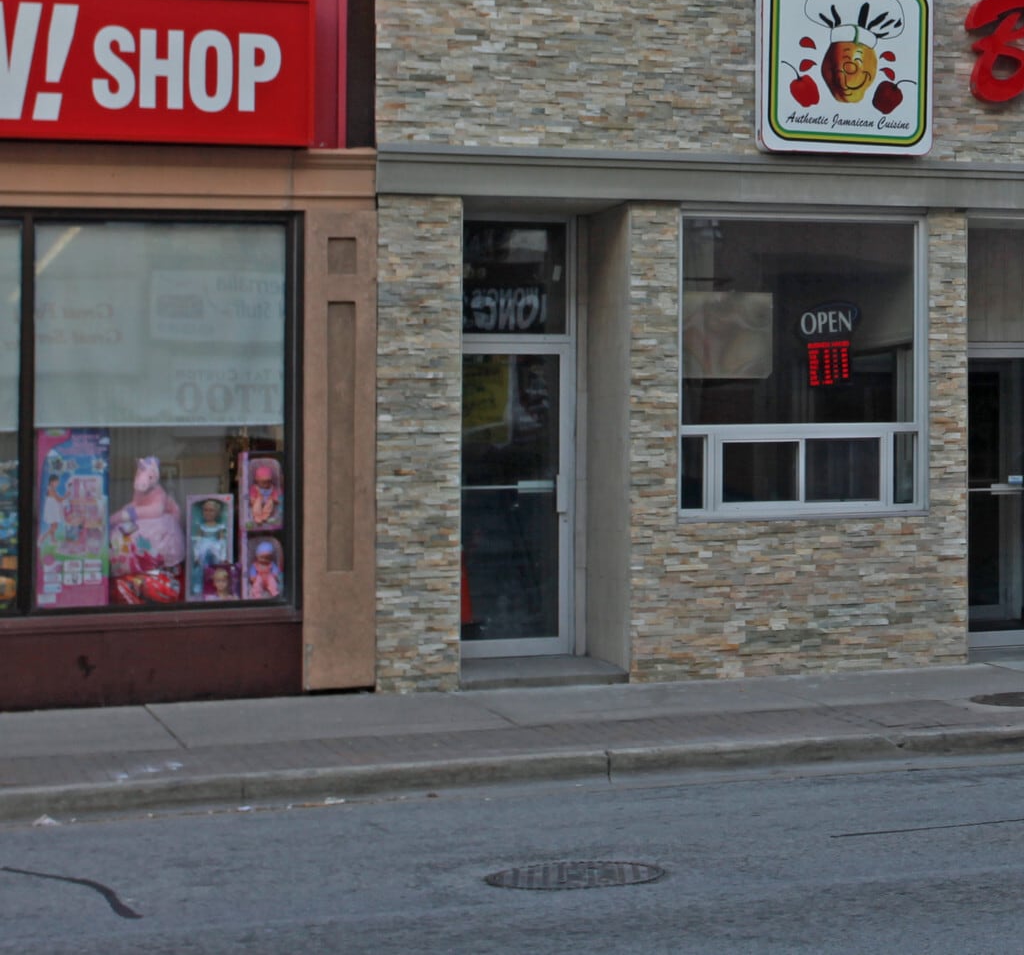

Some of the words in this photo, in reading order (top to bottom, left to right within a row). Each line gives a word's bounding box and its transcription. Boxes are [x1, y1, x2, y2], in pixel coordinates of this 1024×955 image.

[92, 25, 282, 113] SHOP
[786, 111, 829, 125] Authentic
[831, 113, 874, 129] Jamaican
[877, 116, 910, 130] Cuisine
[800, 310, 852, 335] OPEN
